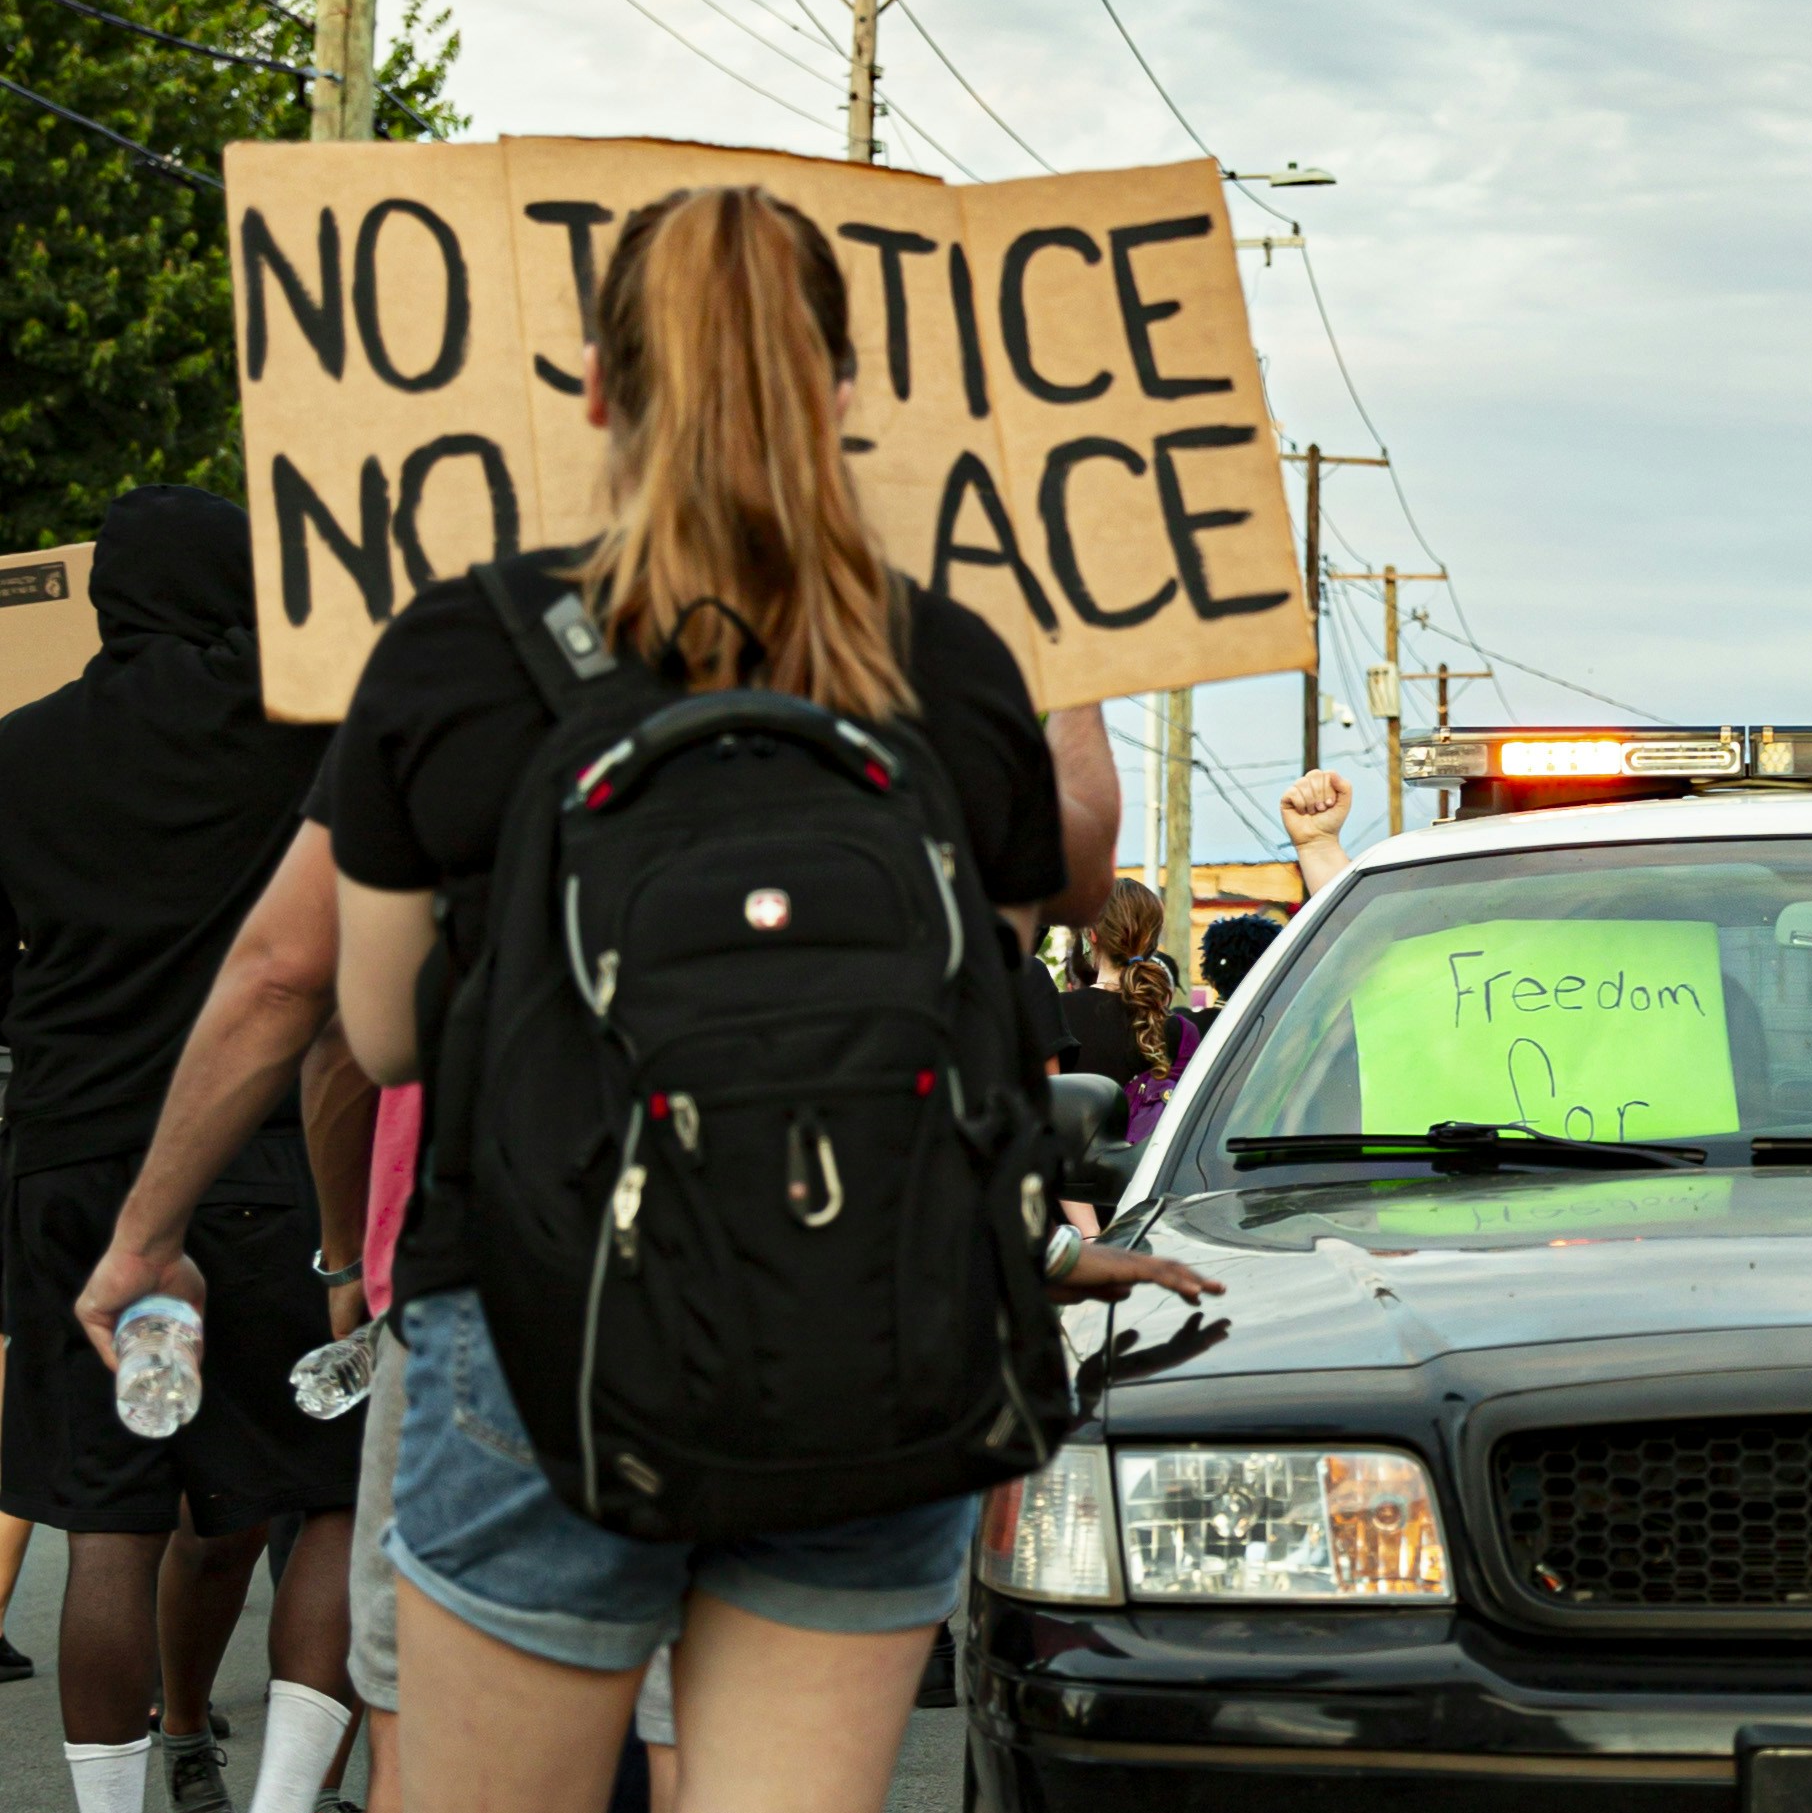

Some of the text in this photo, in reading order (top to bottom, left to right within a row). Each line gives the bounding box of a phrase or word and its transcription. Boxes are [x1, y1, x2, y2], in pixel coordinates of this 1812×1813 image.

[241, 197, 1234, 418] NO JTICE
[271, 424, 1291, 643] NO ACE
[1448, 950, 1705, 1028] Freedom
[1507, 1038, 1650, 1142] for
